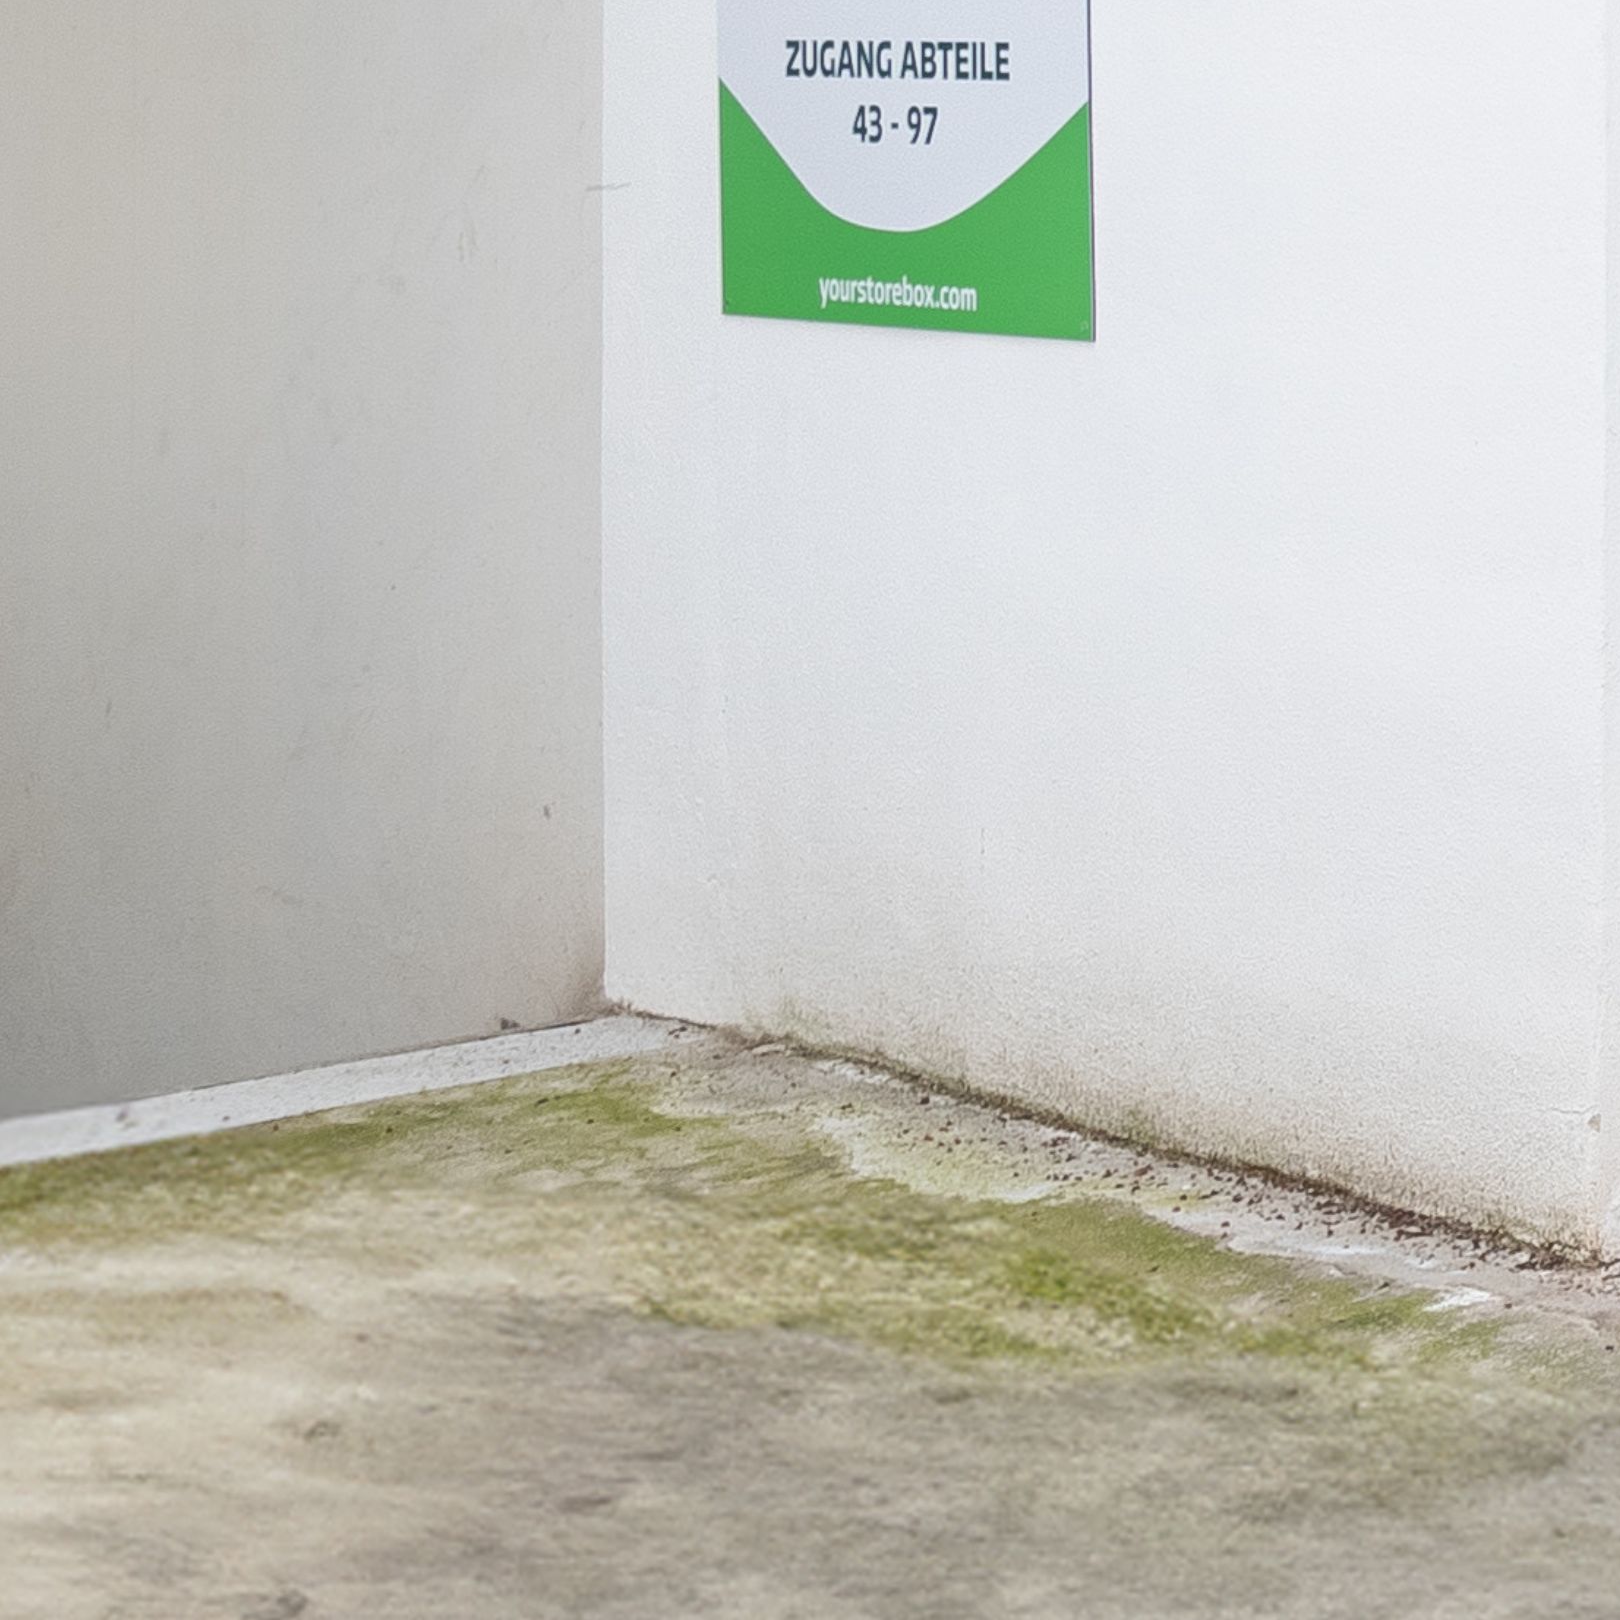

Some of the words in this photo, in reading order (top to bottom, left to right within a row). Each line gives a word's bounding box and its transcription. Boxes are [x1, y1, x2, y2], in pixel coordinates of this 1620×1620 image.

[786, 40, 891, 78] ZUGANG
[900, 42, 1009, 80] ABTEILE
[853, 105, 882, 143] 43
[907, 106, 937, 144] 97
[819, 276, 977, 311] yourstorebox.com
